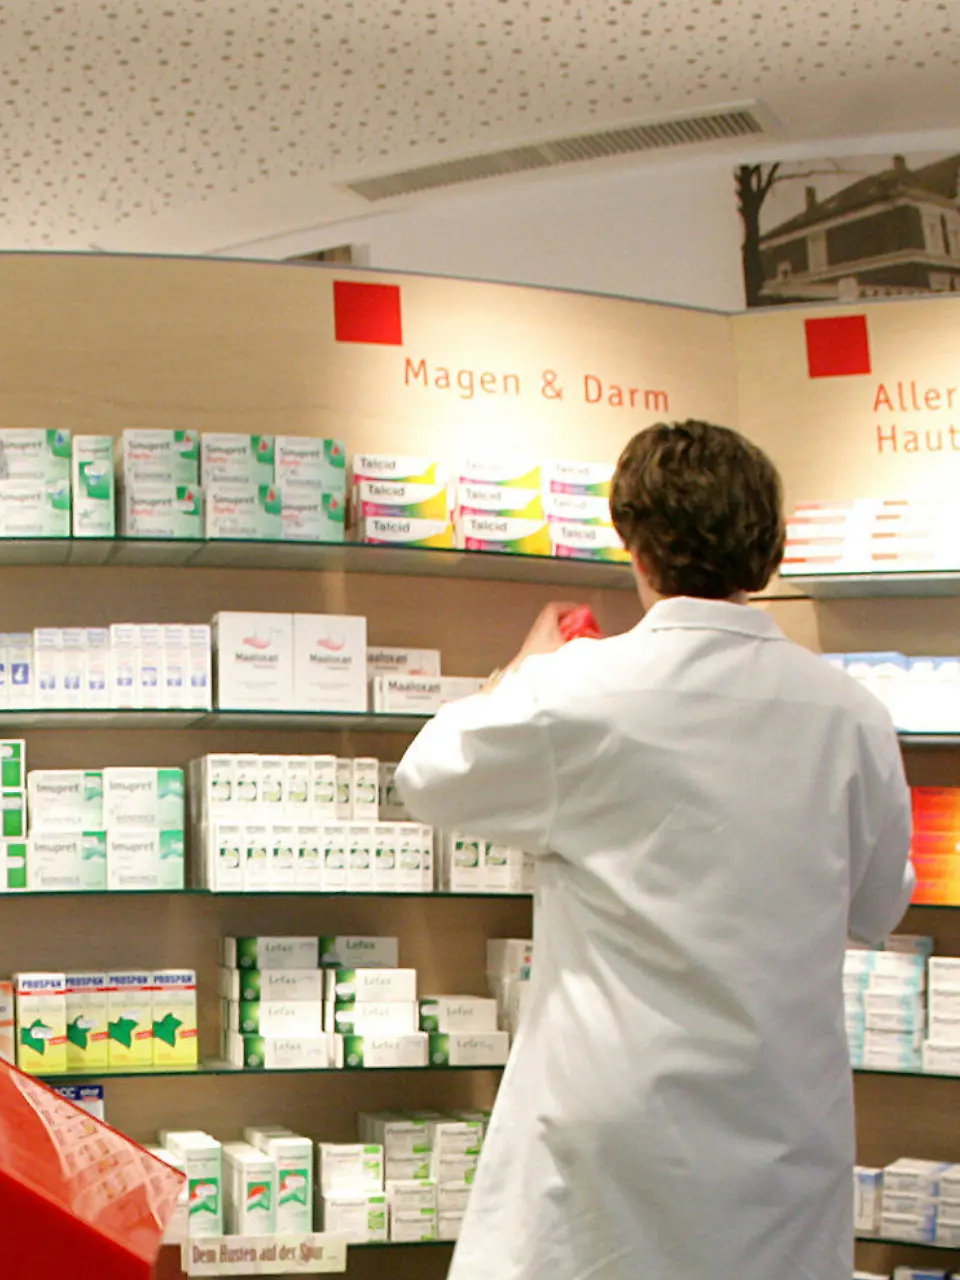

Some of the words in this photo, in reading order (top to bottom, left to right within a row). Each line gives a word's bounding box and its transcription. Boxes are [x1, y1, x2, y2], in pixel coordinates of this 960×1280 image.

[404, 357, 520, 400] Magen
[541, 369, 563, 400] &
[584, 374, 669, 413] Darm
[360, 458, 397, 471] Talcid
[368, 485, 406, 498] Talcid
[372, 520, 411, 534] Talcid
[470, 520, 508, 533] Talcid
[560, 527, 598, 541] Talcid
[22, 979, 62, 989] PROSPAN
[109, 976, 148, 986] PROSPAN
[153, 974, 193, 984] PROSPAN
